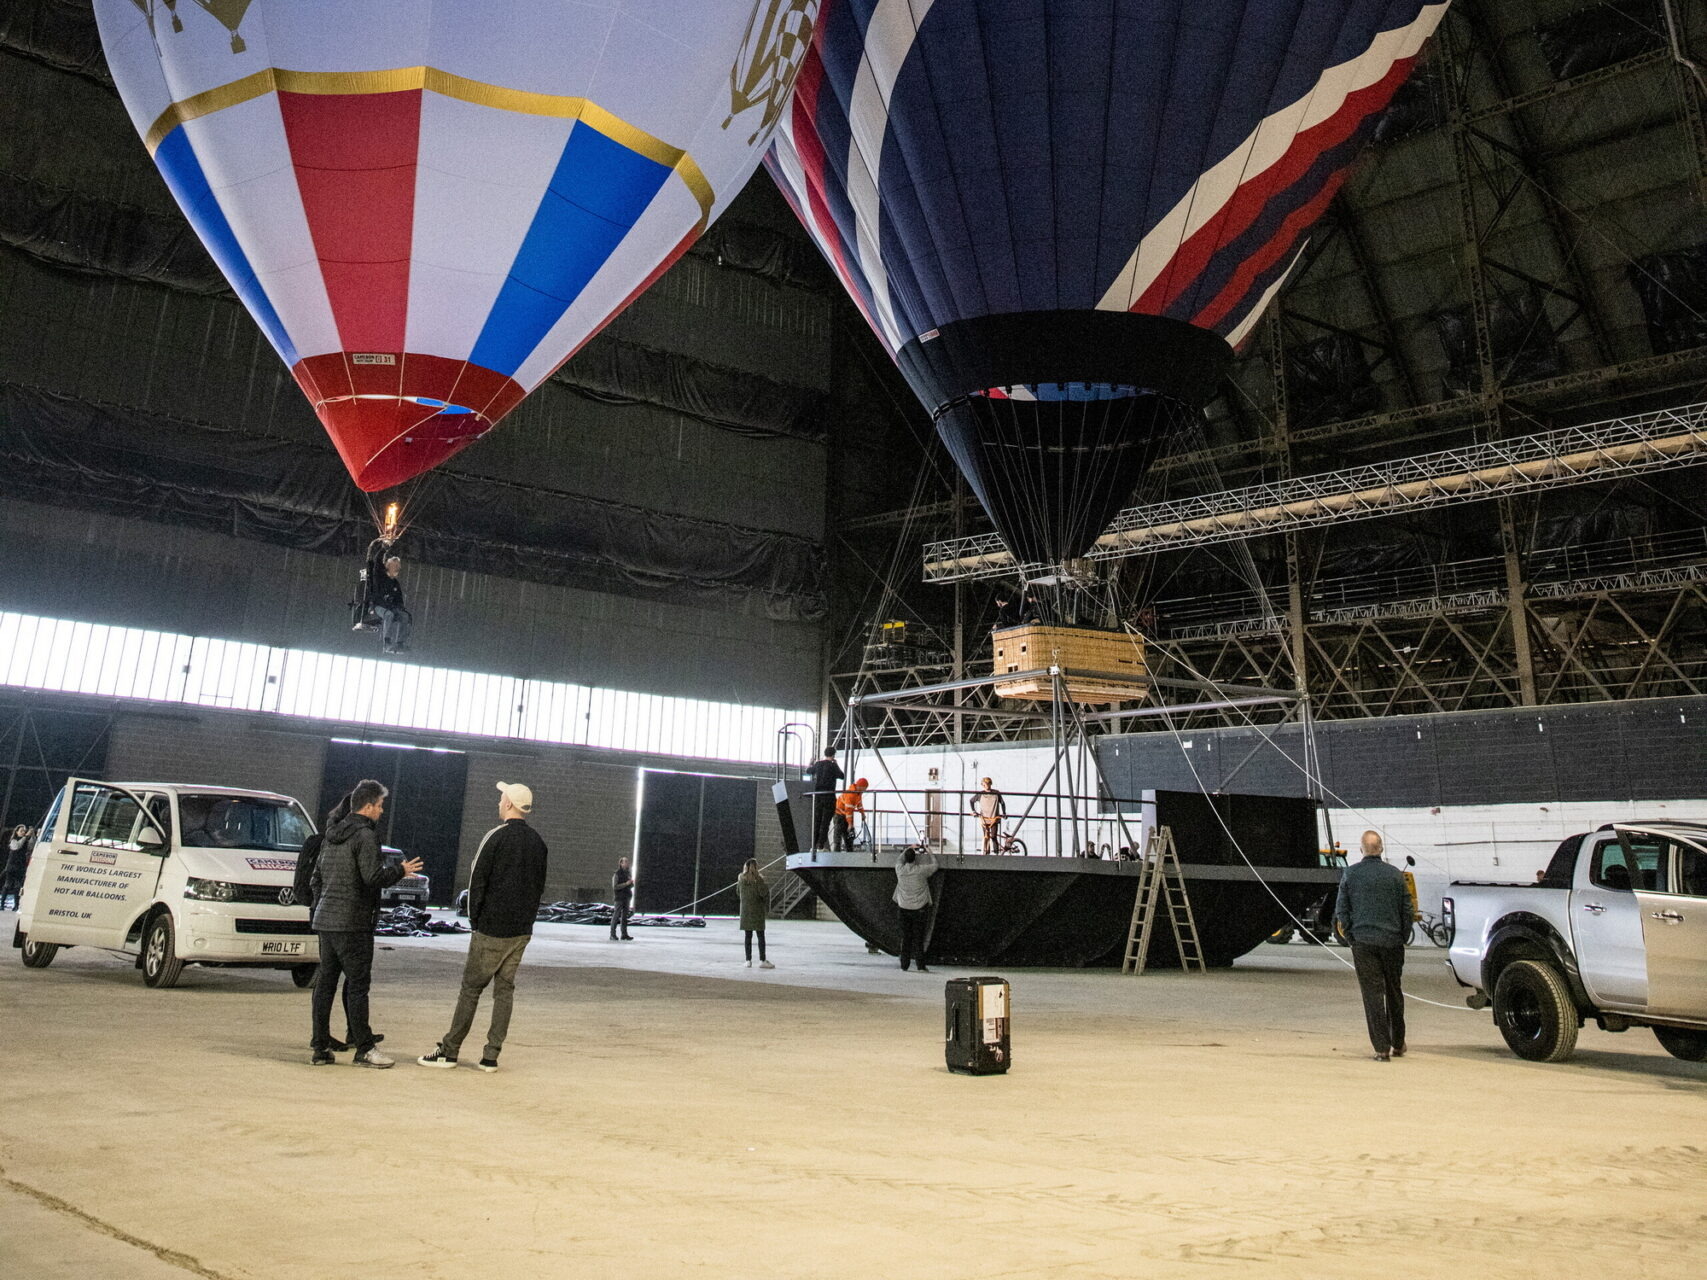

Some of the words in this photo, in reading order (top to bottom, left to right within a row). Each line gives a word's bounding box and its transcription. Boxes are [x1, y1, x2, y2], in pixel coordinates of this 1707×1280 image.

[60, 863, 76, 872] THE
[76, 865, 107, 875] WORLDS
[108, 869, 142, 879] LARGEST
[56, 875, 117, 889] MANUFACTURER
[118, 882, 130, 890] OF
[53, 887, 70, 895] HOT
[70, 888, 85, 897] AIR
[85, 890, 128, 901] BALLOONS.
[48, 908, 79, 918] BRISTOL
[80, 911, 93, 919] UK
[262, 942, 283, 953] WR10
[283, 942, 301, 953] LTF
